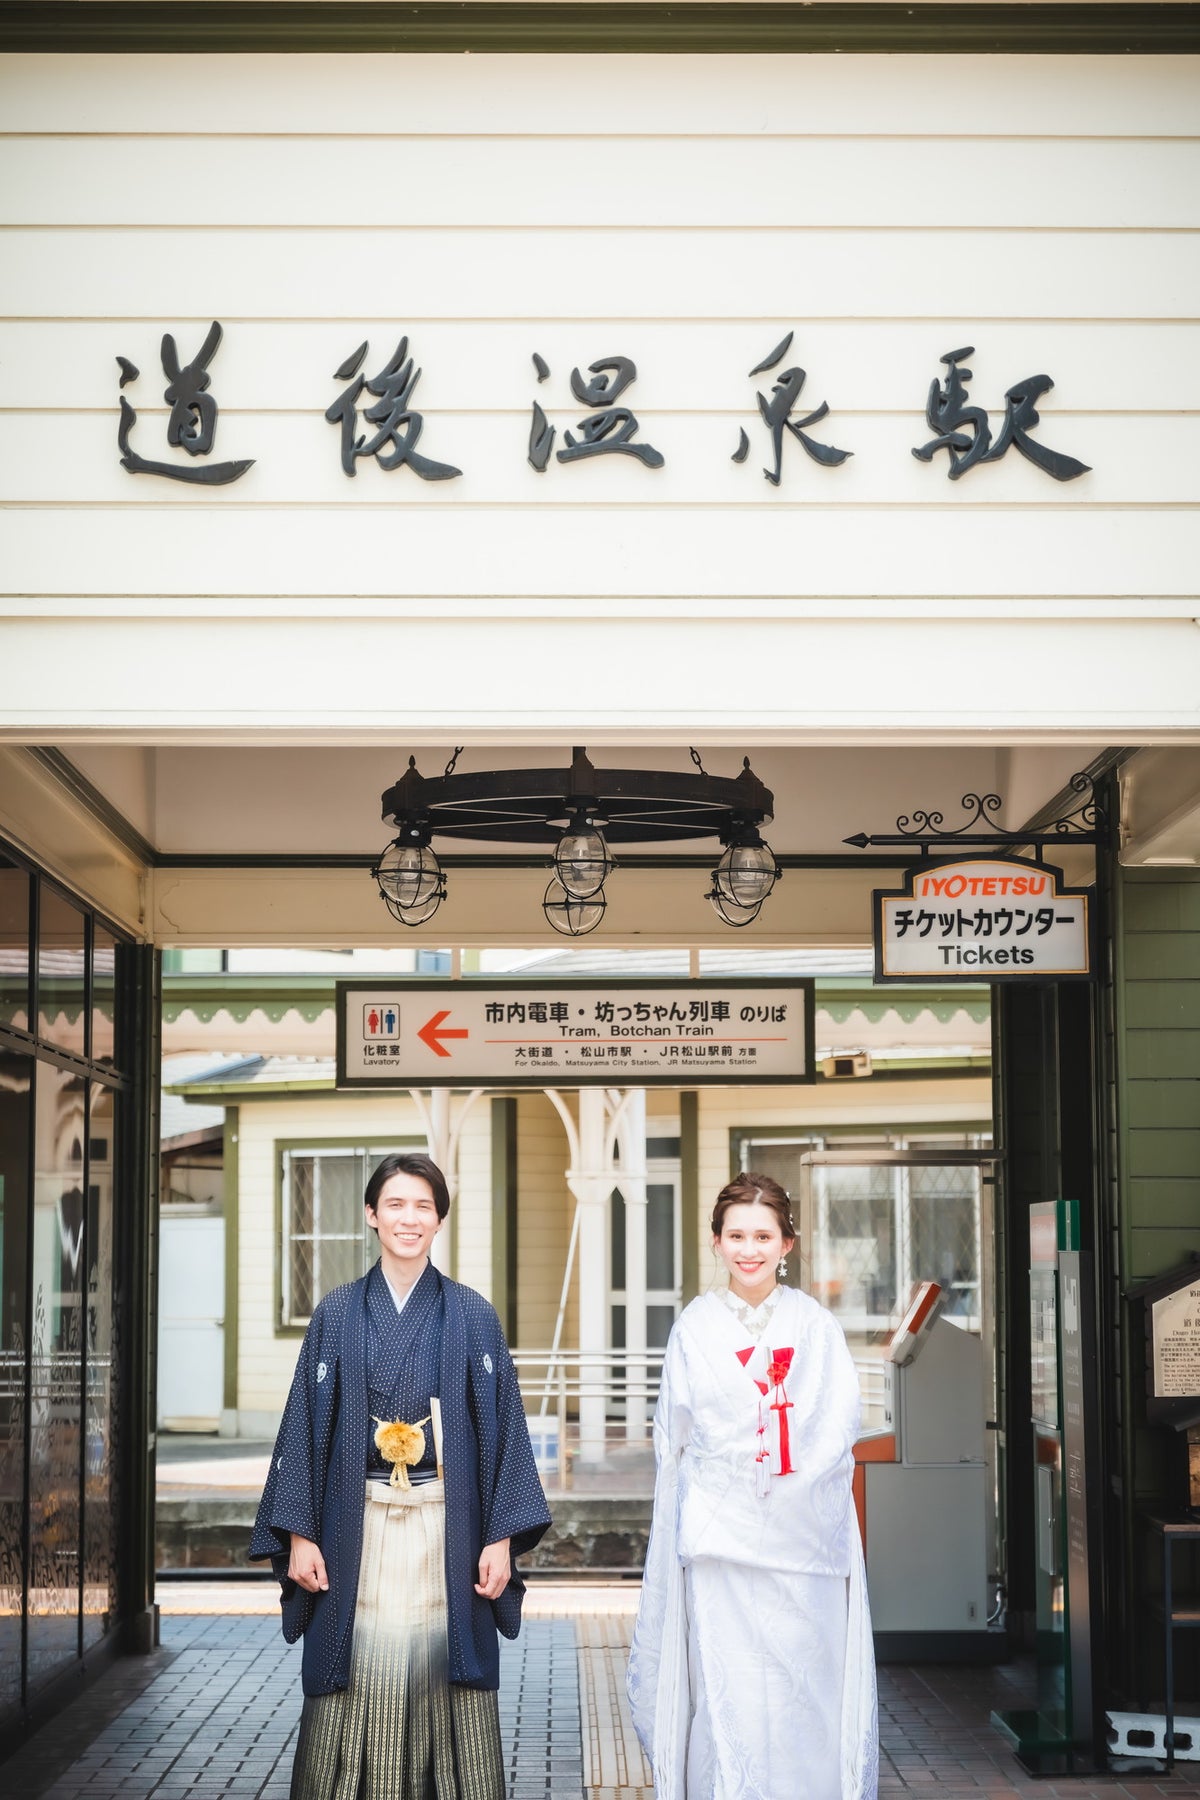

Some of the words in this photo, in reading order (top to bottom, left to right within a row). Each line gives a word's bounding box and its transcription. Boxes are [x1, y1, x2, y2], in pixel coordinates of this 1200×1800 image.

[114, 320, 1093, 487] 道後温泉駅
[921, 874, 1046, 899] IYOTETSU
[894, 907, 1075, 938] チケットカウンター
[937, 945, 1035, 965] Tickets
[740, 1004, 788, 1023] のりば
[558, 1026, 601, 1038] Tram,
[610, 1024, 671, 1037] Botchan
[675, 1024, 715, 1036] Train
[363, 1044, 401, 1057] 化粧室
[515, 1046, 553, 1058] 大街道
[580, 1046, 632, 1058] 松山市駅
[363, 1058, 400, 1067] Lavatory
[565, 1060, 610, 1068] Matsuyama
[612, 1059, 628, 1067] City
[681, 1059, 726, 1067] Matsuyama
[728, 1058, 757, 1066] Station
